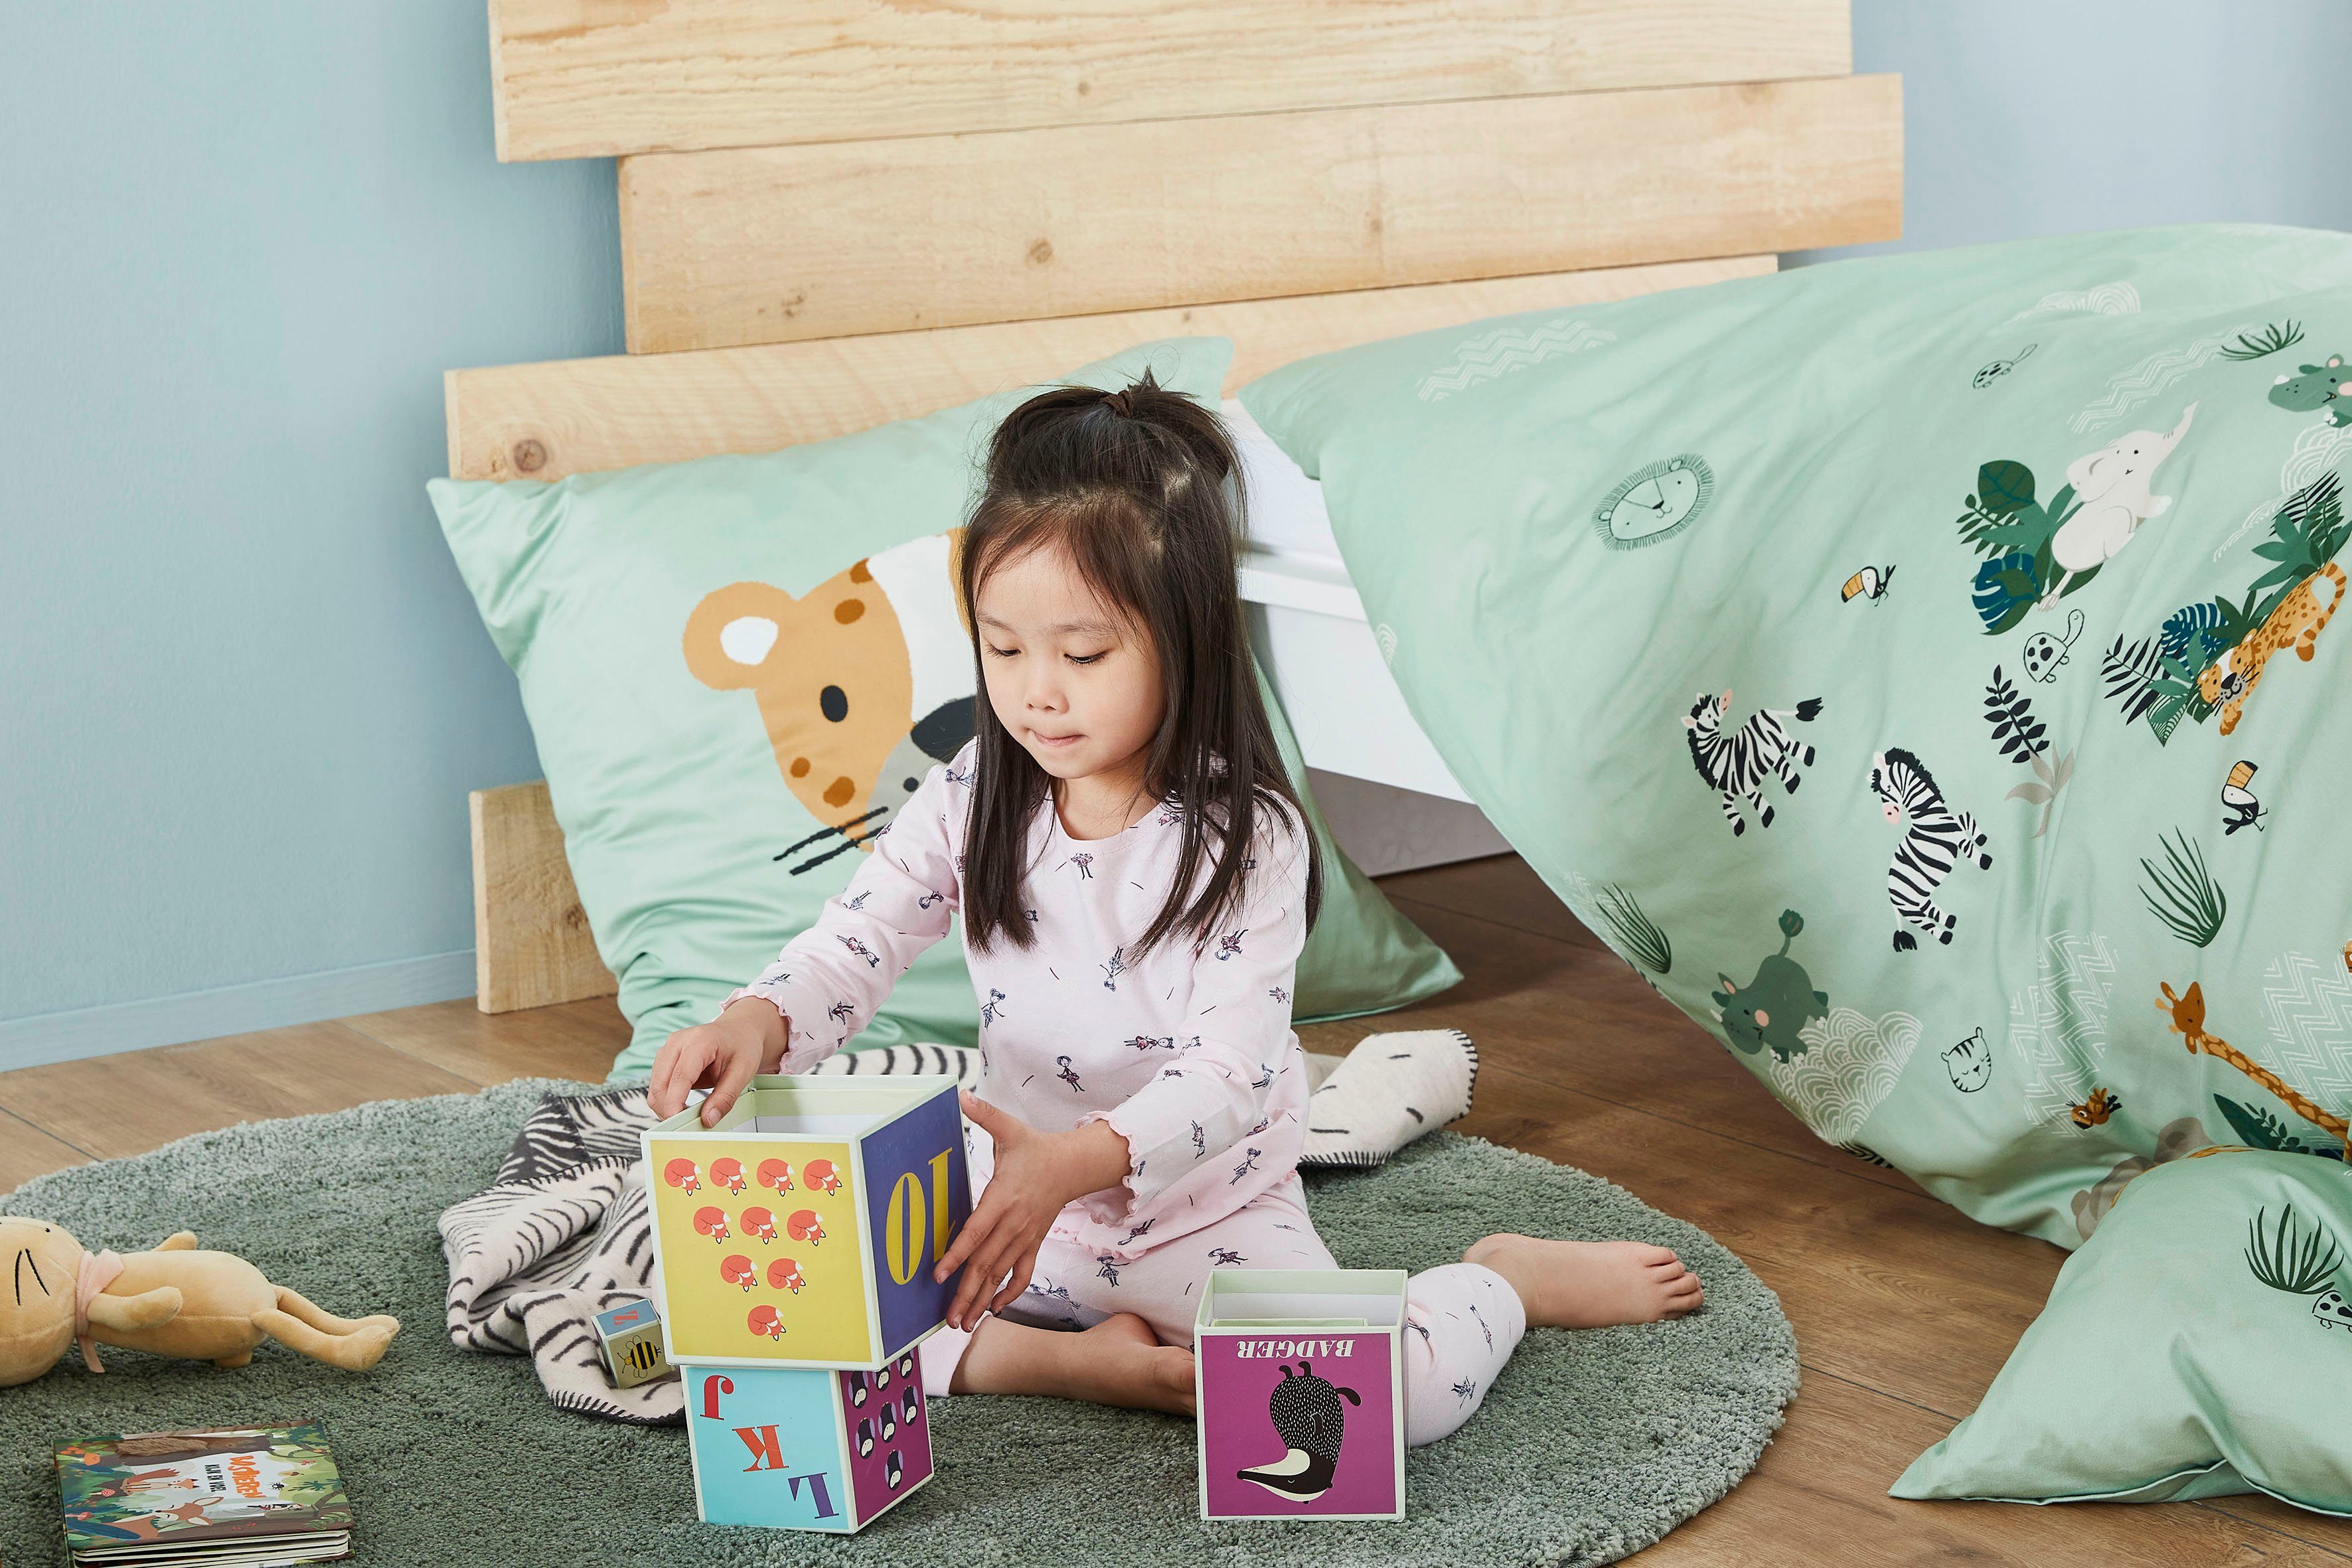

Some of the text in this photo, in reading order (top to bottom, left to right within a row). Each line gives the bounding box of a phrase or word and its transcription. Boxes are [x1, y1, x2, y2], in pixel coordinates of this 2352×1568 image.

[886, 1146, 956, 1285] 10
[1237, 1340, 1356, 1358] BADGER
[700, 1375, 734, 1421] J
[204, 1464, 222, 1474] KIJK
[732, 1424, 789, 1472] K
[209, 1481, 226, 1492] VOEL
[788, 1472, 839, 1519] L
